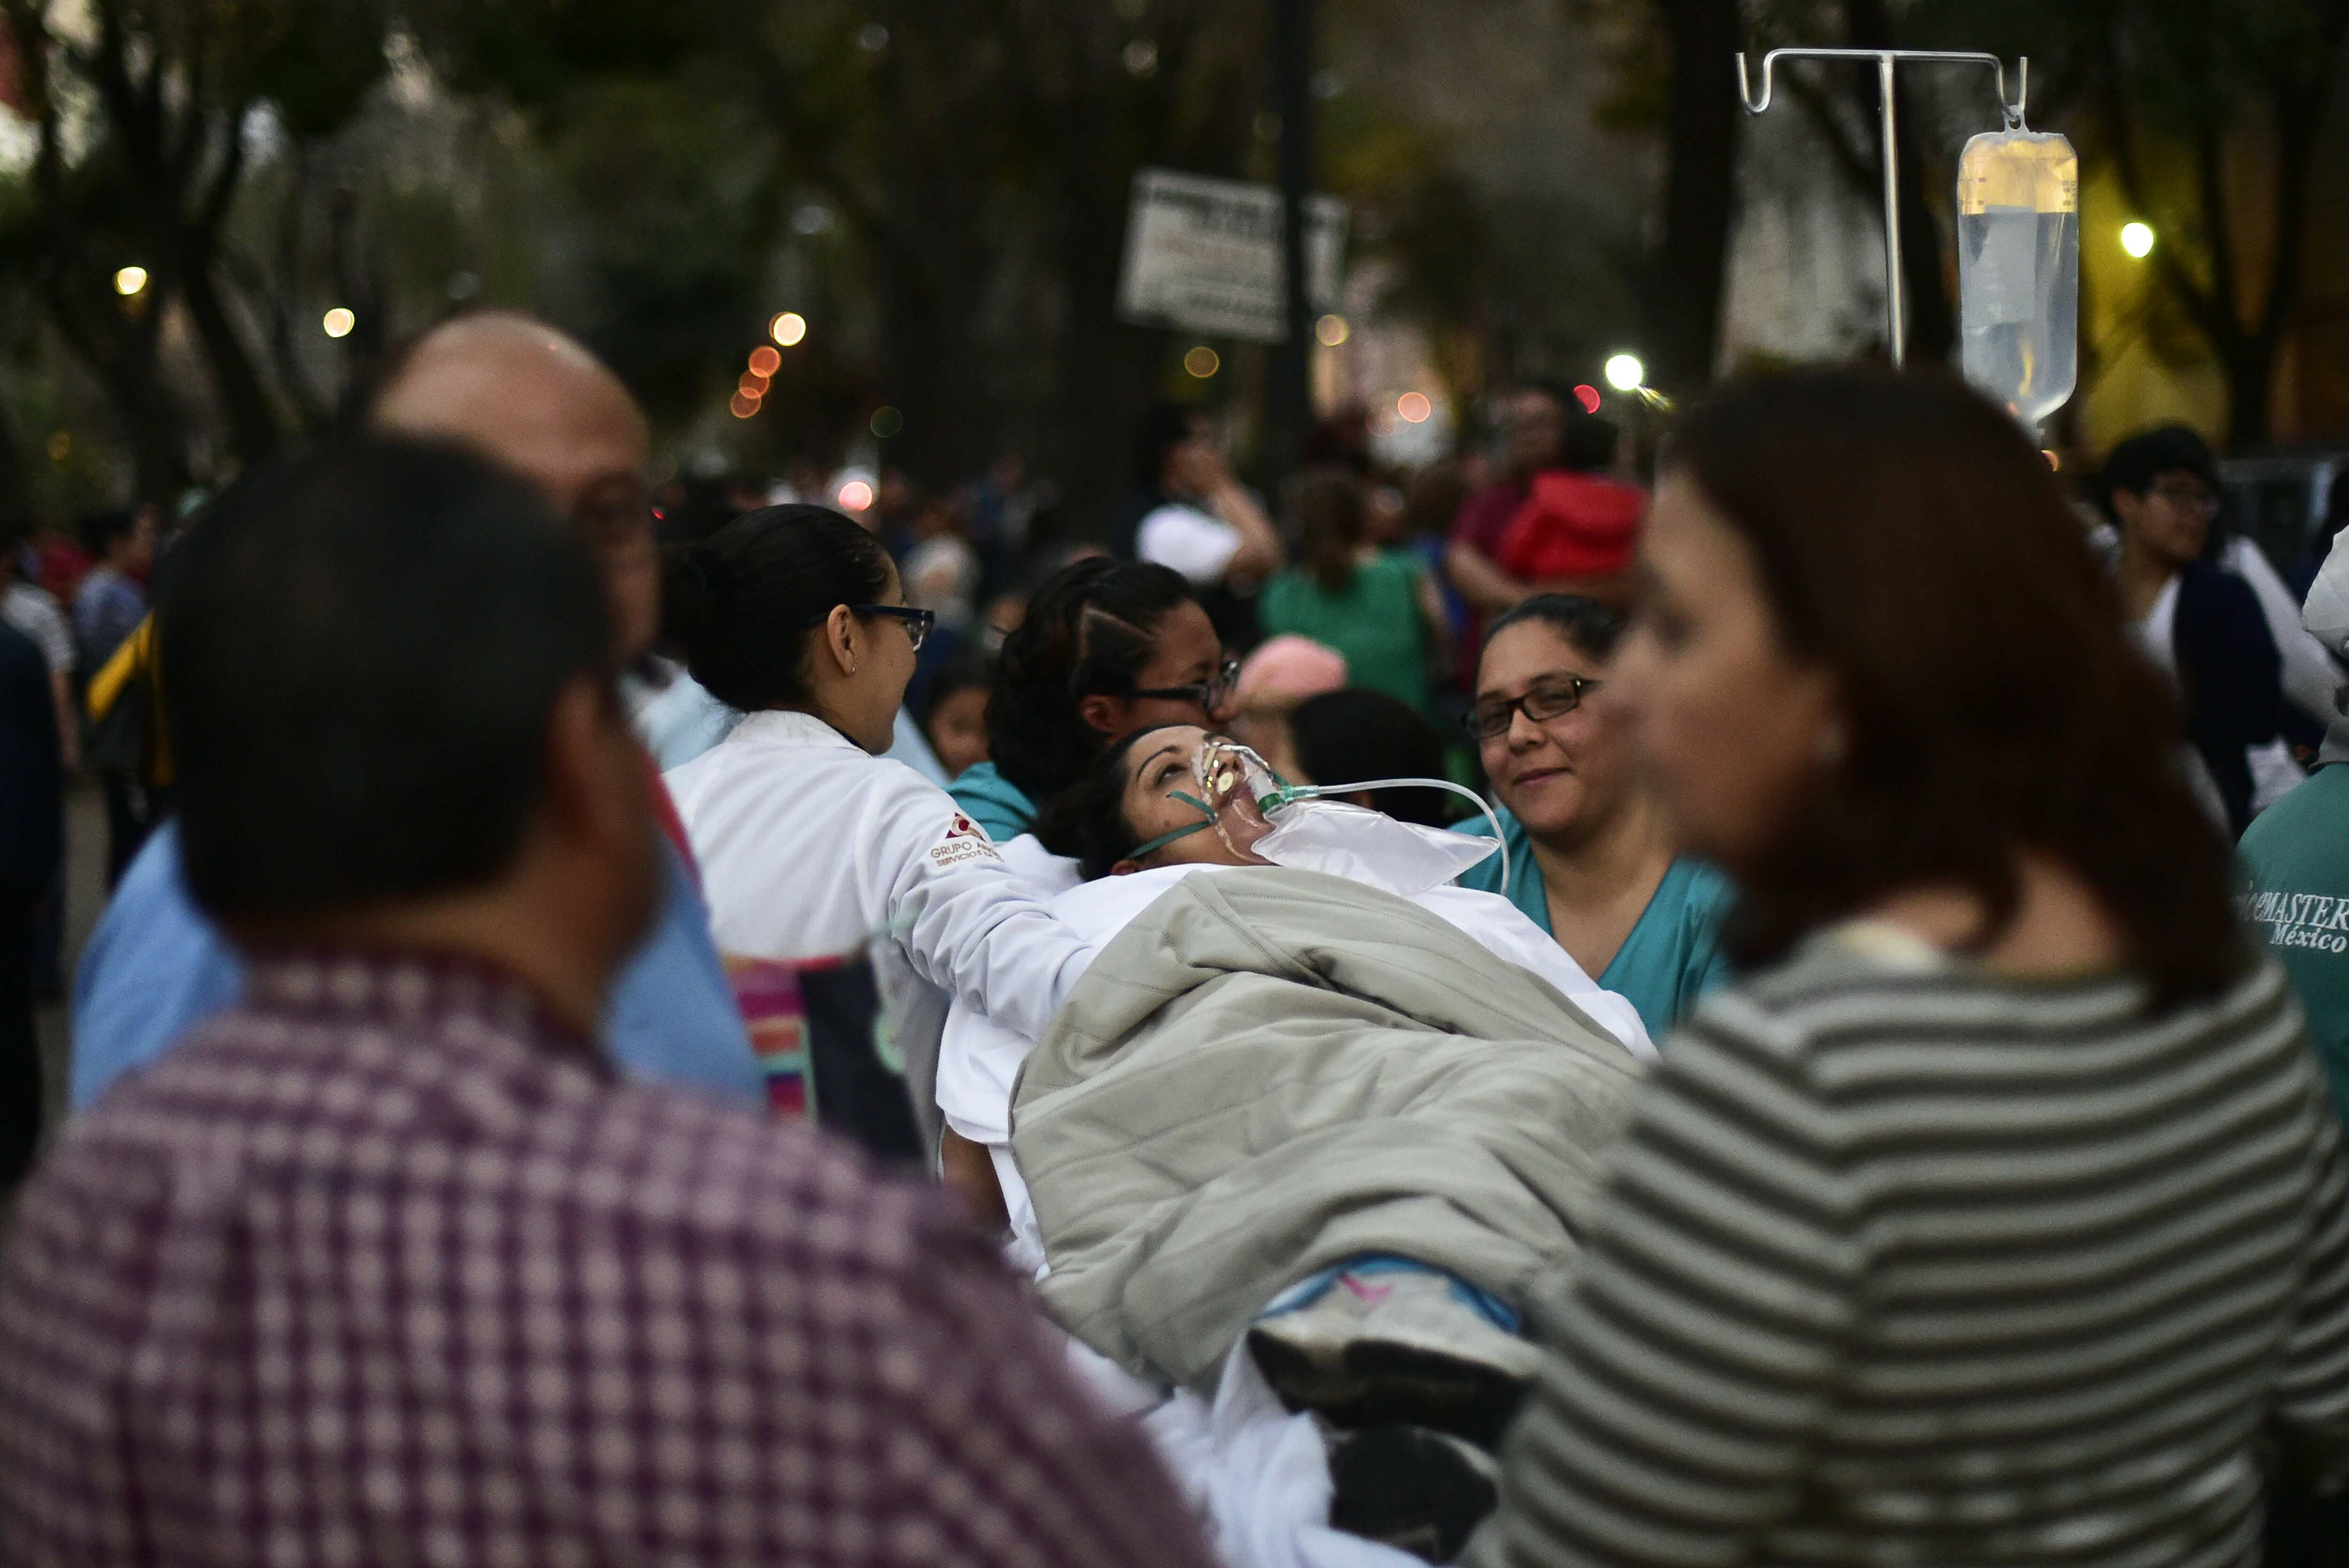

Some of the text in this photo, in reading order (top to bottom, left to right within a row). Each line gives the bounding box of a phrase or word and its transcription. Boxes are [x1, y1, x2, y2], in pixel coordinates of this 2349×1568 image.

[931, 841, 972, 858] GRUPO
[936, 850, 982, 867] SERVICIOS
[2270, 923, 2348, 953] México
